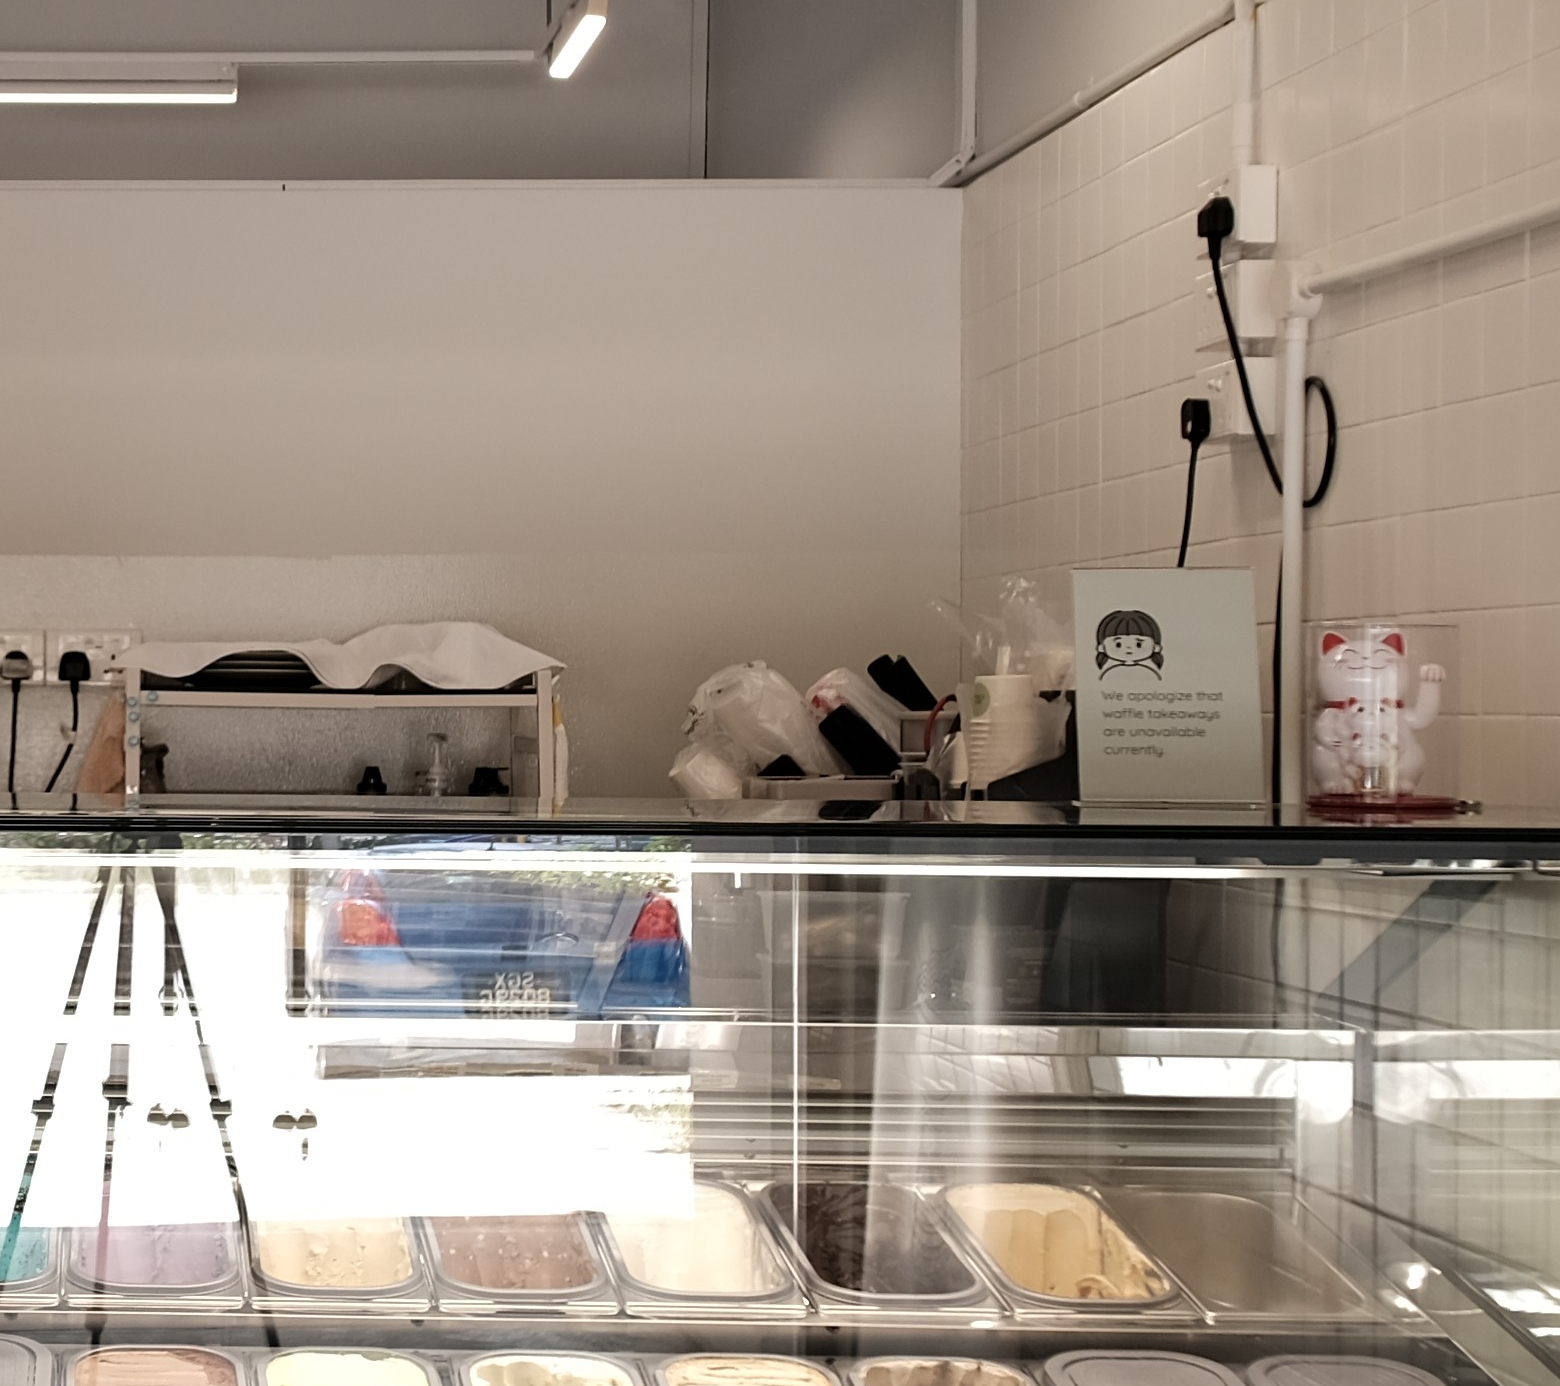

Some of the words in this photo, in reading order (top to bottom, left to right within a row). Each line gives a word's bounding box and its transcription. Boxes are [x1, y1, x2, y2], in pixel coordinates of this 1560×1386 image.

[1101, 691, 1124, 701] We
[1126, 691, 1193, 704] apologize
[1195, 691, 1224, 701] that
[1102, 708, 1144, 719] waffle
[1147, 709, 1222, 722] takeaways
[1102, 727, 1126, 737] are
[1129, 726, 1207, 737] unavailable
[1103, 744, 1166, 758] currently.
